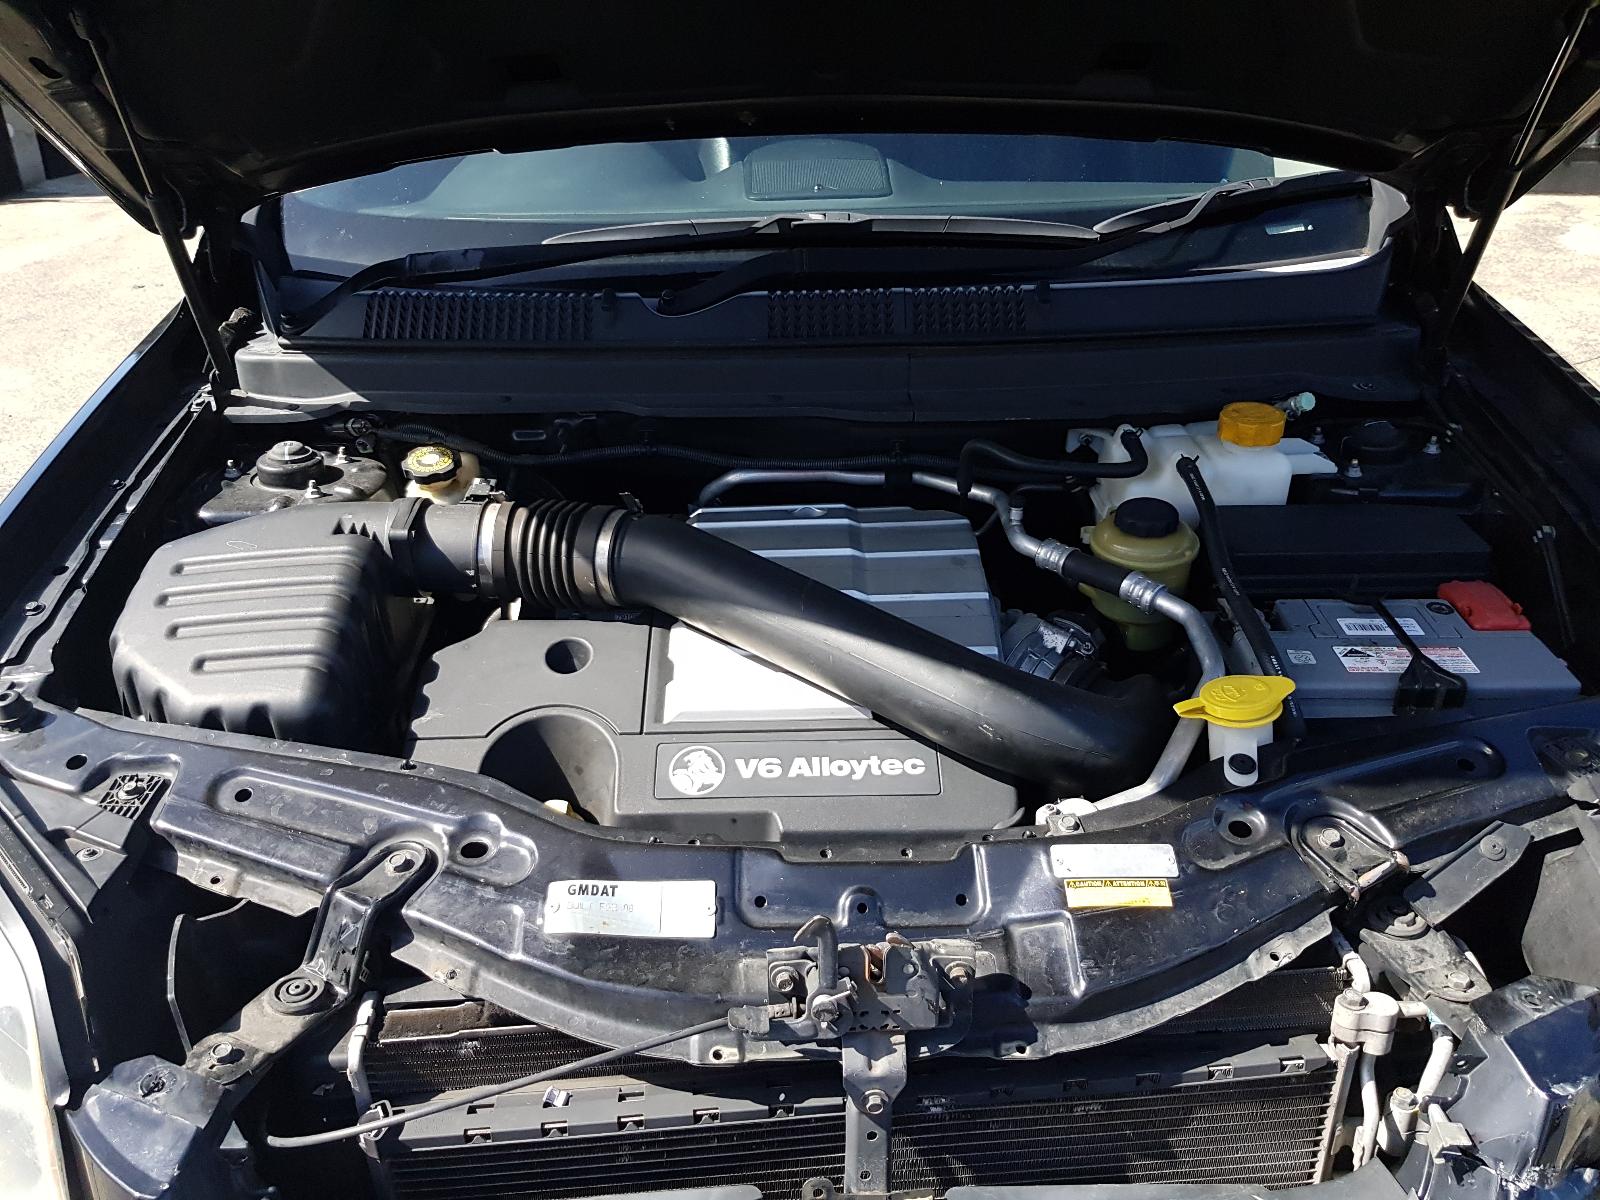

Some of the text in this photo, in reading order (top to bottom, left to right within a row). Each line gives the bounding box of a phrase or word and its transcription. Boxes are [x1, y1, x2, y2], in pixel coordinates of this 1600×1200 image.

[735, 755, 926, 781] V6 Alloytec
[567, 884, 619, 897] GMDAT
